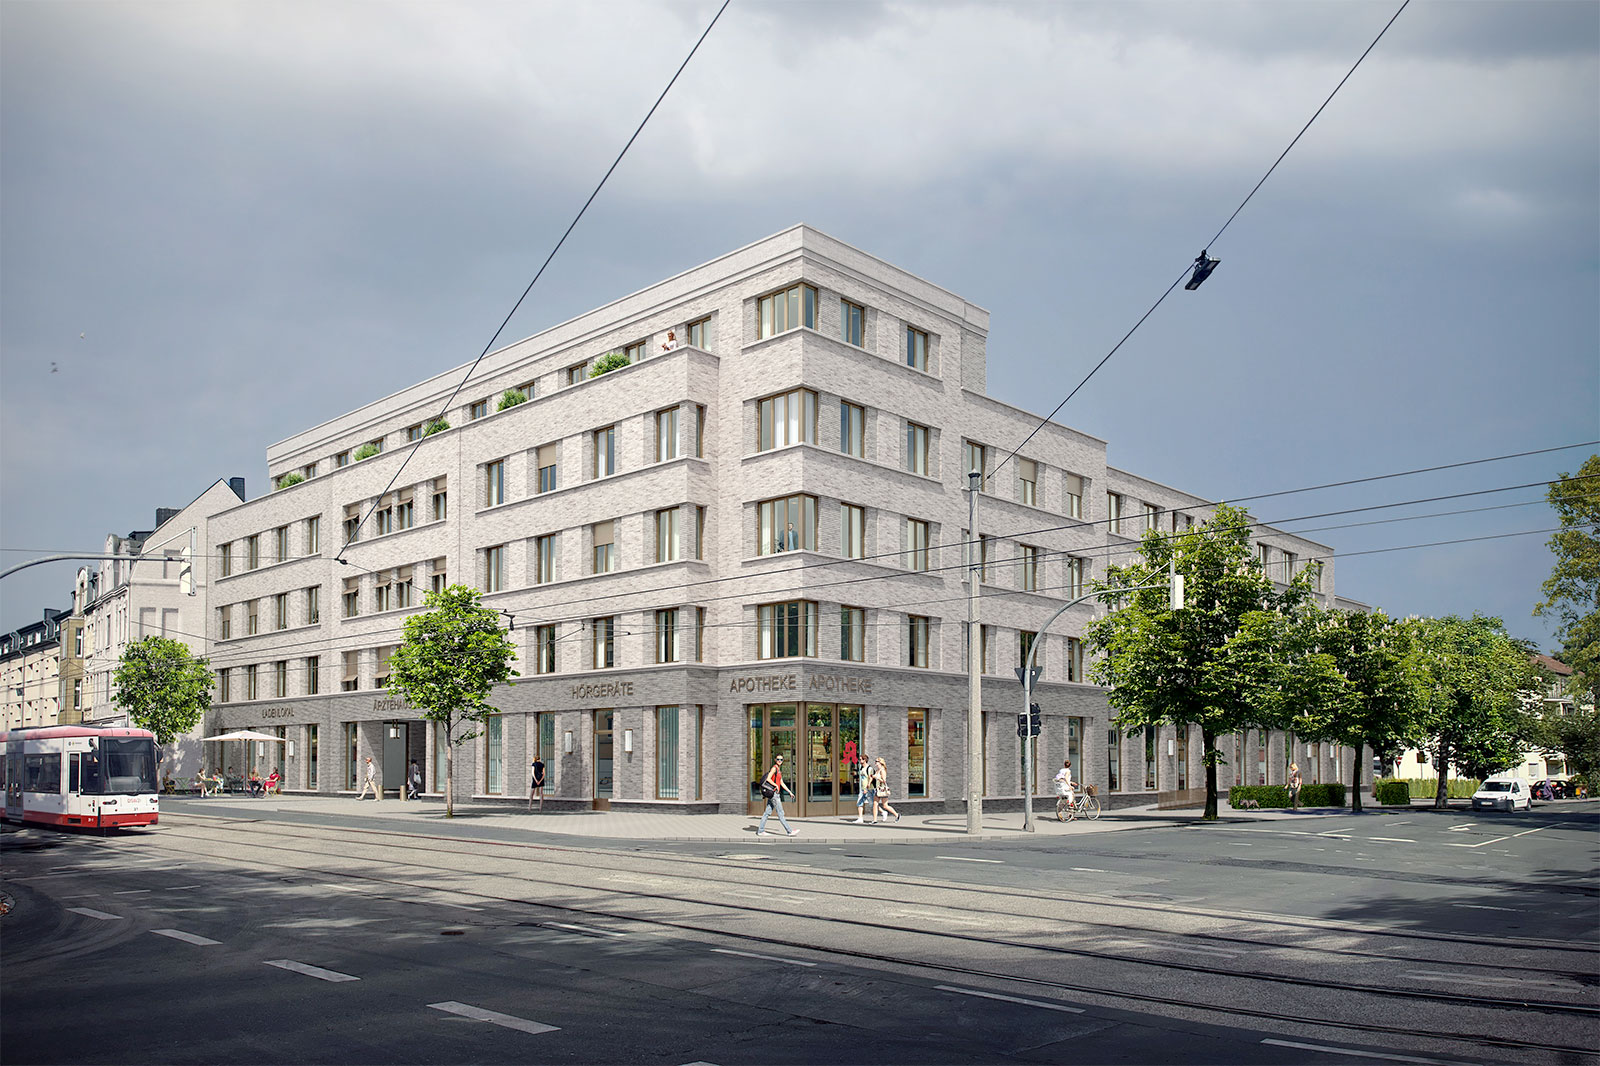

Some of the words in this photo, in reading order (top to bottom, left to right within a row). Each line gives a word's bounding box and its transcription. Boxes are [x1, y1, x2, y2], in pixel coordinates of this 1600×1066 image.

[571, 681, 634, 700] HÖRGERÄTE
[730, 674, 796, 693] APOTHEKE
[809, 674, 872, 694] APOTHEKE
